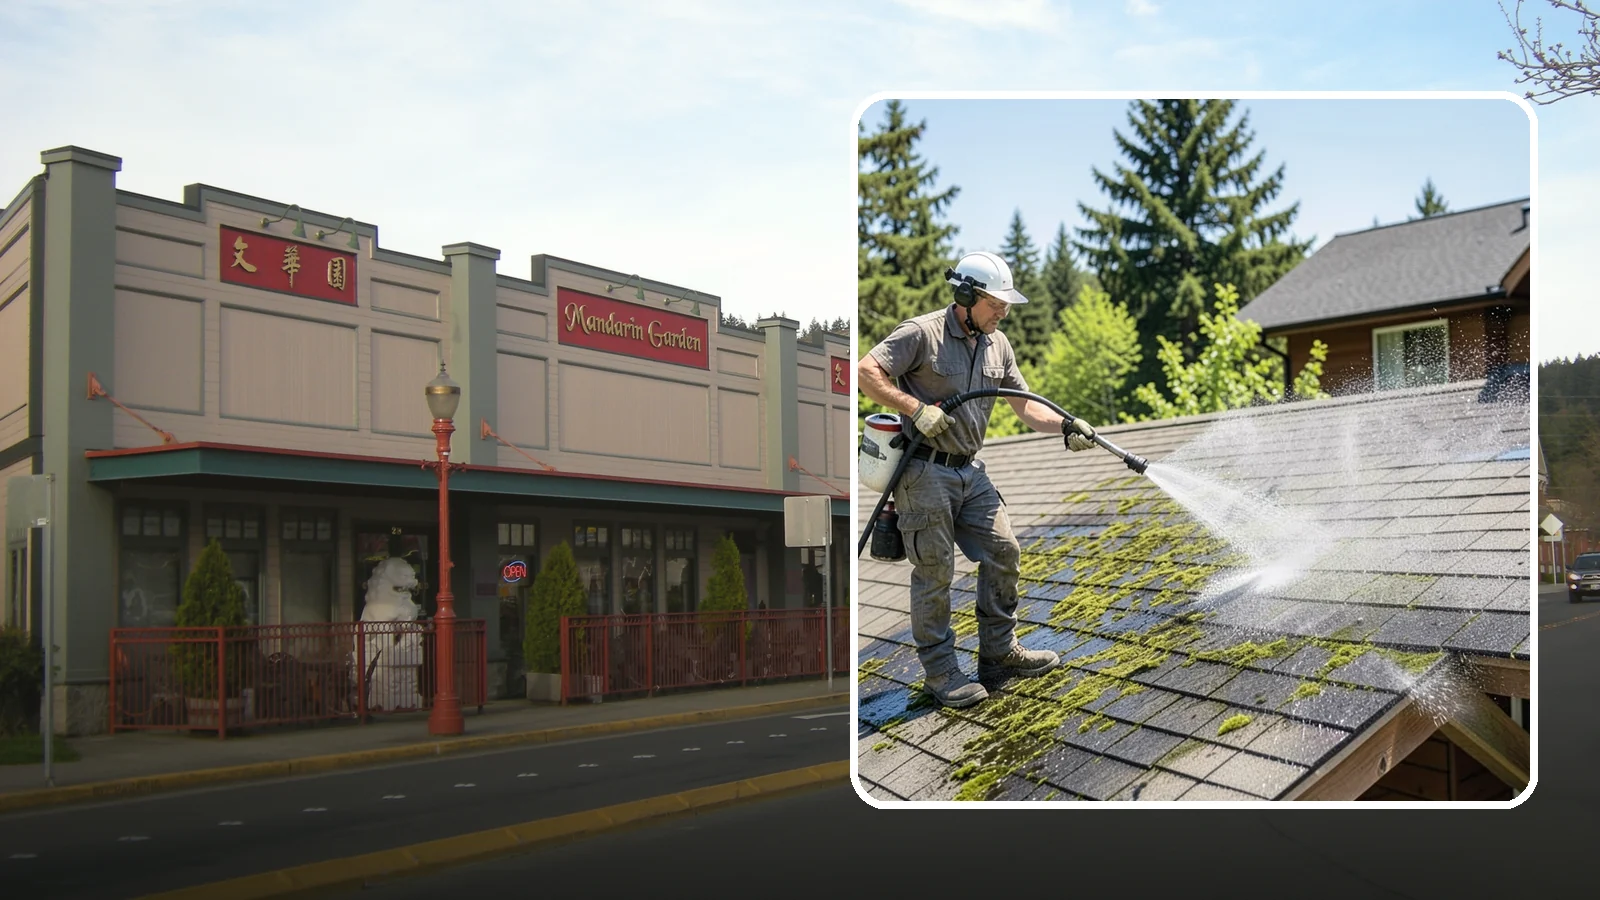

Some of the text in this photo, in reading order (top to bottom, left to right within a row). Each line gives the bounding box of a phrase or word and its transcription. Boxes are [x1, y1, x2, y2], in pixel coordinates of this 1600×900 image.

[231, 235, 346, 290] 文華園
[564, 302, 701, 352] Mandarin Garden
[834, 362, 846, 386] 文
[503, 565, 527, 578] OPEN
